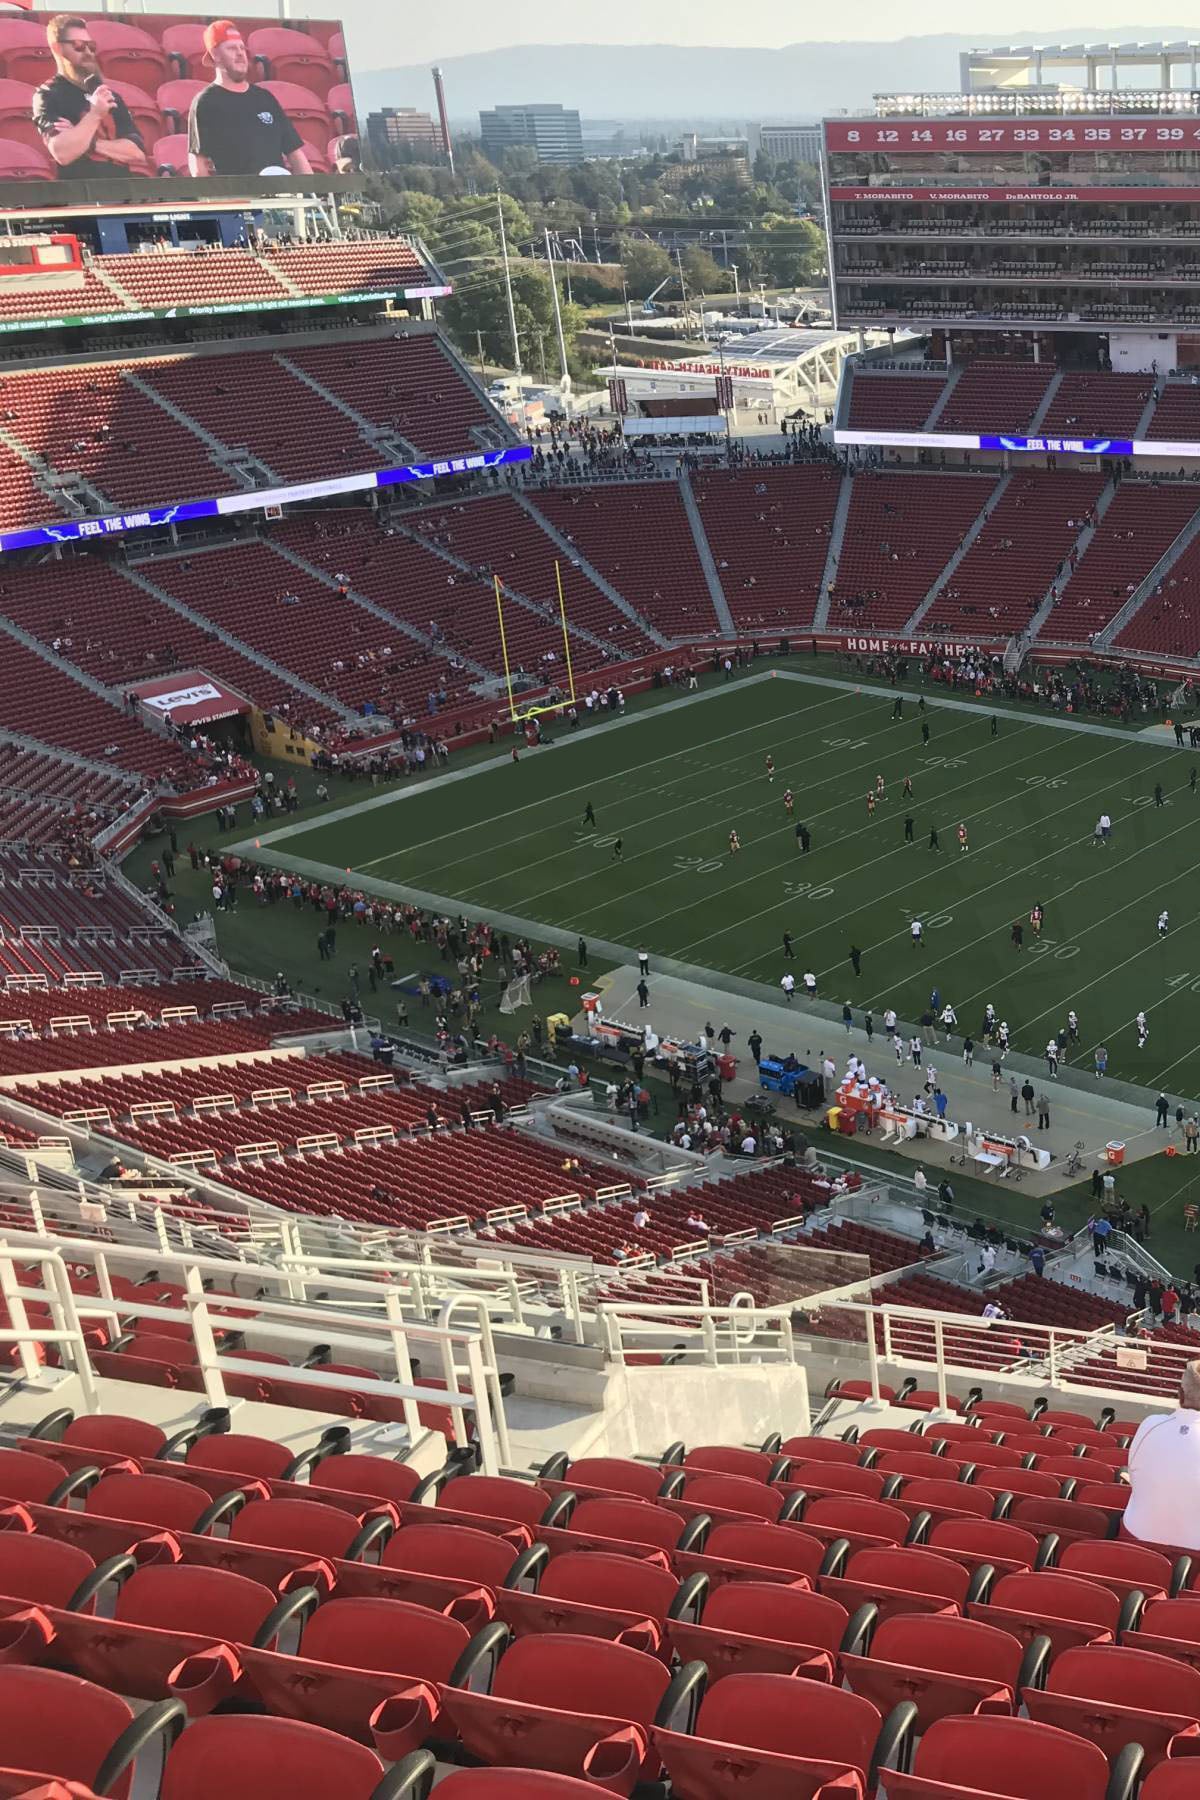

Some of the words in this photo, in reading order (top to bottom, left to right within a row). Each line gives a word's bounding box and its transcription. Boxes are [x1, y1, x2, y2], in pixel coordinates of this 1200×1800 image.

[847, 130, 860, 142] 8
[877, 130, 899, 142] 12
[911, 130, 933, 142] 14
[946, 129, 967, 142] 16
[978, 129, 1005, 142] 27
[1013, 129, 1040, 141] 33
[1048, 128, 1076, 141] 34
[1084, 128, 1111, 141] 35
[1120, 128, 1147, 141] 37
[1156, 128, 1184, 140] 39
[1027, 439, 1045, 450] FEEL
[1046, 439, 1061, 451] THE
[433, 462, 451, 475] FEEL
[451, 459, 466, 471] THE
[78, 521, 103, 537] FEEL
[103, 517, 123, 532] THE
[847, 638, 889, 652] HOME
[784, 881, 834, 900] 30
[1027, 939, 1081, 960] 50
